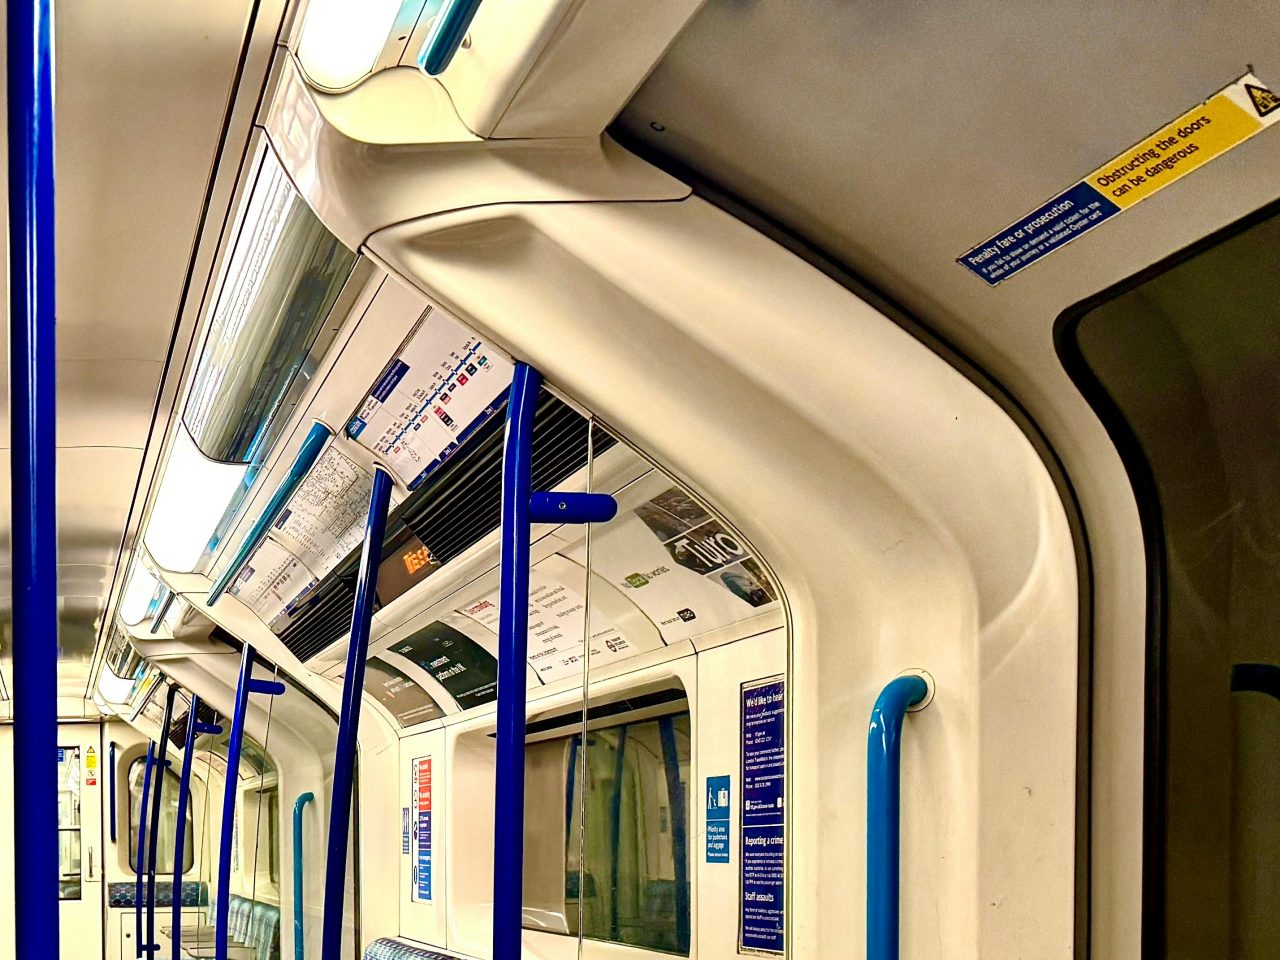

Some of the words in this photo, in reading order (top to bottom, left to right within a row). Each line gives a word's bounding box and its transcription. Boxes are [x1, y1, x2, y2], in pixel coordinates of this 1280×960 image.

[1096, 148, 1161, 187] Obstructing
[1155, 136, 1179, 151] the
[1177, 116, 1211, 138] doors
[1112, 184, 1132, 197] can
[1127, 175, 1147, 187] be
[1145, 143, 1199, 177] dangerous
[968, 245, 1000, 265] Penalty
[996, 235, 1016, 250] fare
[1014, 229, 1025, 239] or
[1023, 199, 1074, 235] prosecution
[673, 533, 744, 568] Turo
[745, 836, 766, 847] Reporting
[770, 835, 784, 845] crime
[745, 891, 756, 901] Staff
[756, 892, 774, 902] assaults
